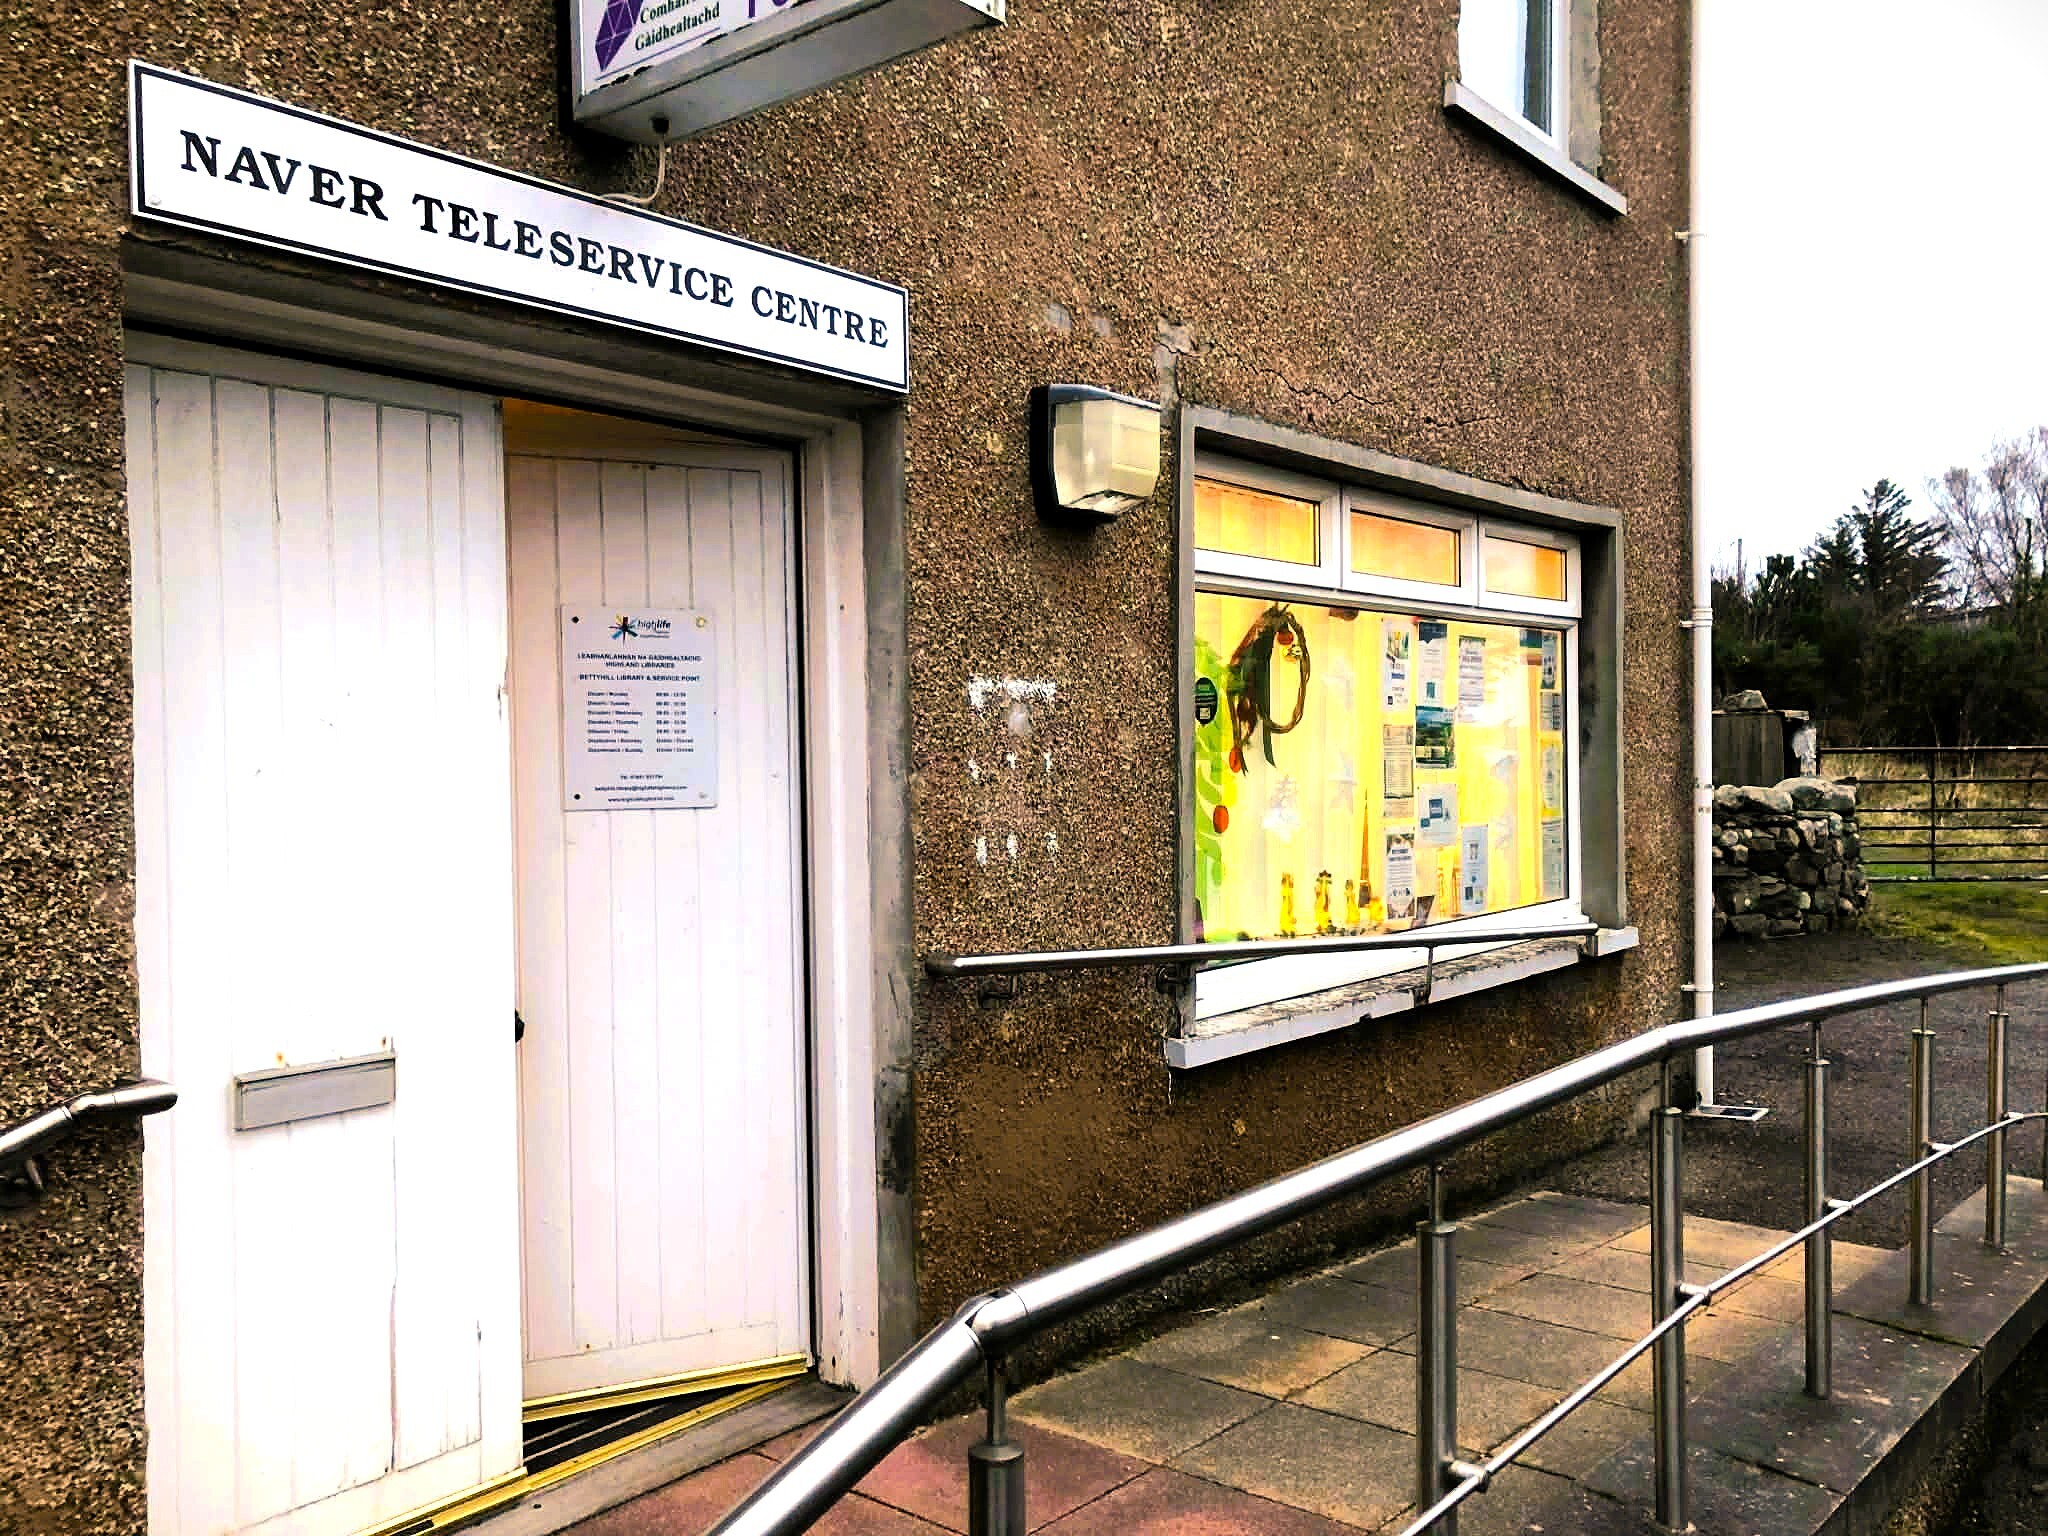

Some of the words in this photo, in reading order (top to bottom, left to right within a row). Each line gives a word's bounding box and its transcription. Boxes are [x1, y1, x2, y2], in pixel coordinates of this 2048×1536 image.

[180, 129, 389, 221] NAVER
[411, 193, 734, 308] TELESERVICE
[751, 285, 888, 348] CENTRE
